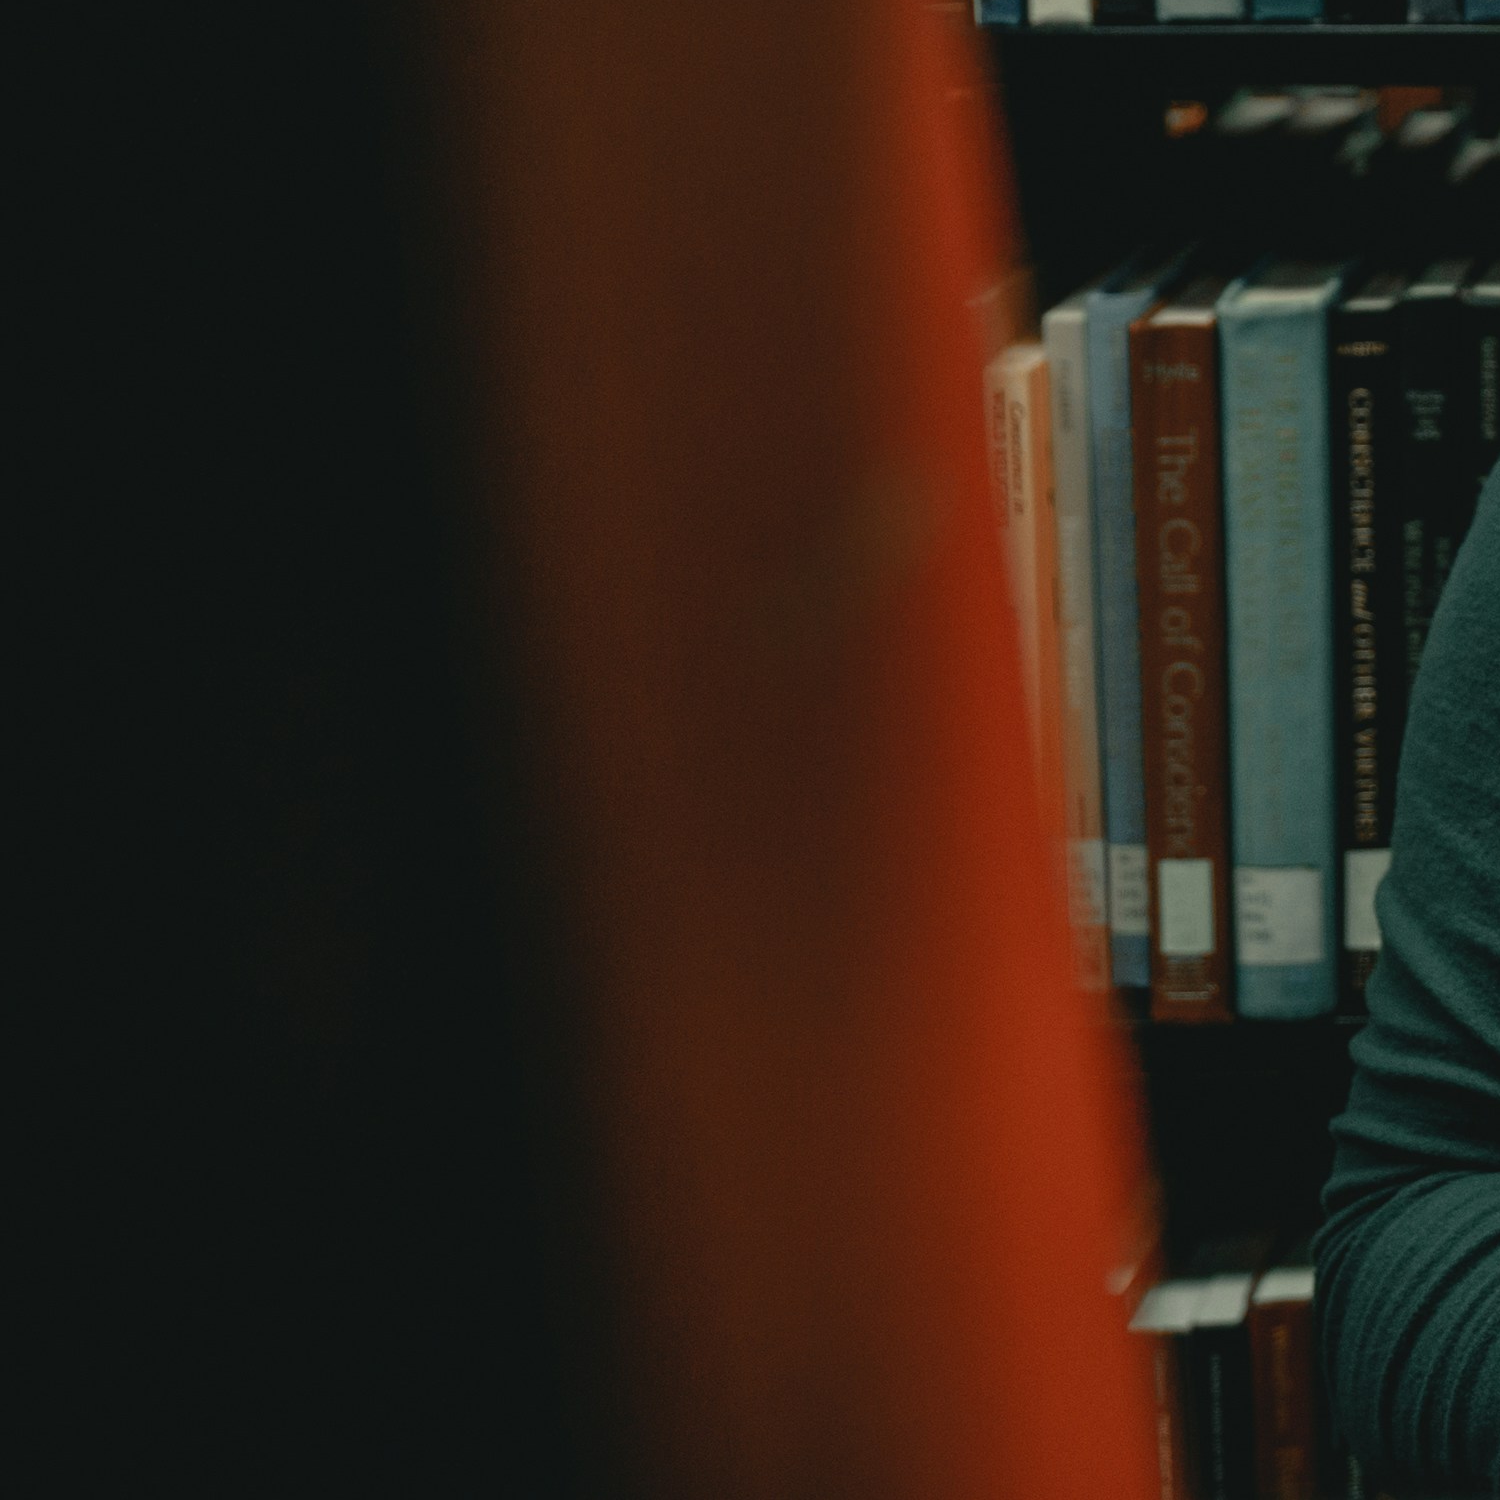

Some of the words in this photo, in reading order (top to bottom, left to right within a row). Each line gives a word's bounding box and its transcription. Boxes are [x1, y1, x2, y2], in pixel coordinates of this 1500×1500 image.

[1156, 426, 1200, 505] The
[1158, 516, 1206, 596] Call
[1160, 605, 1206, 651] of
